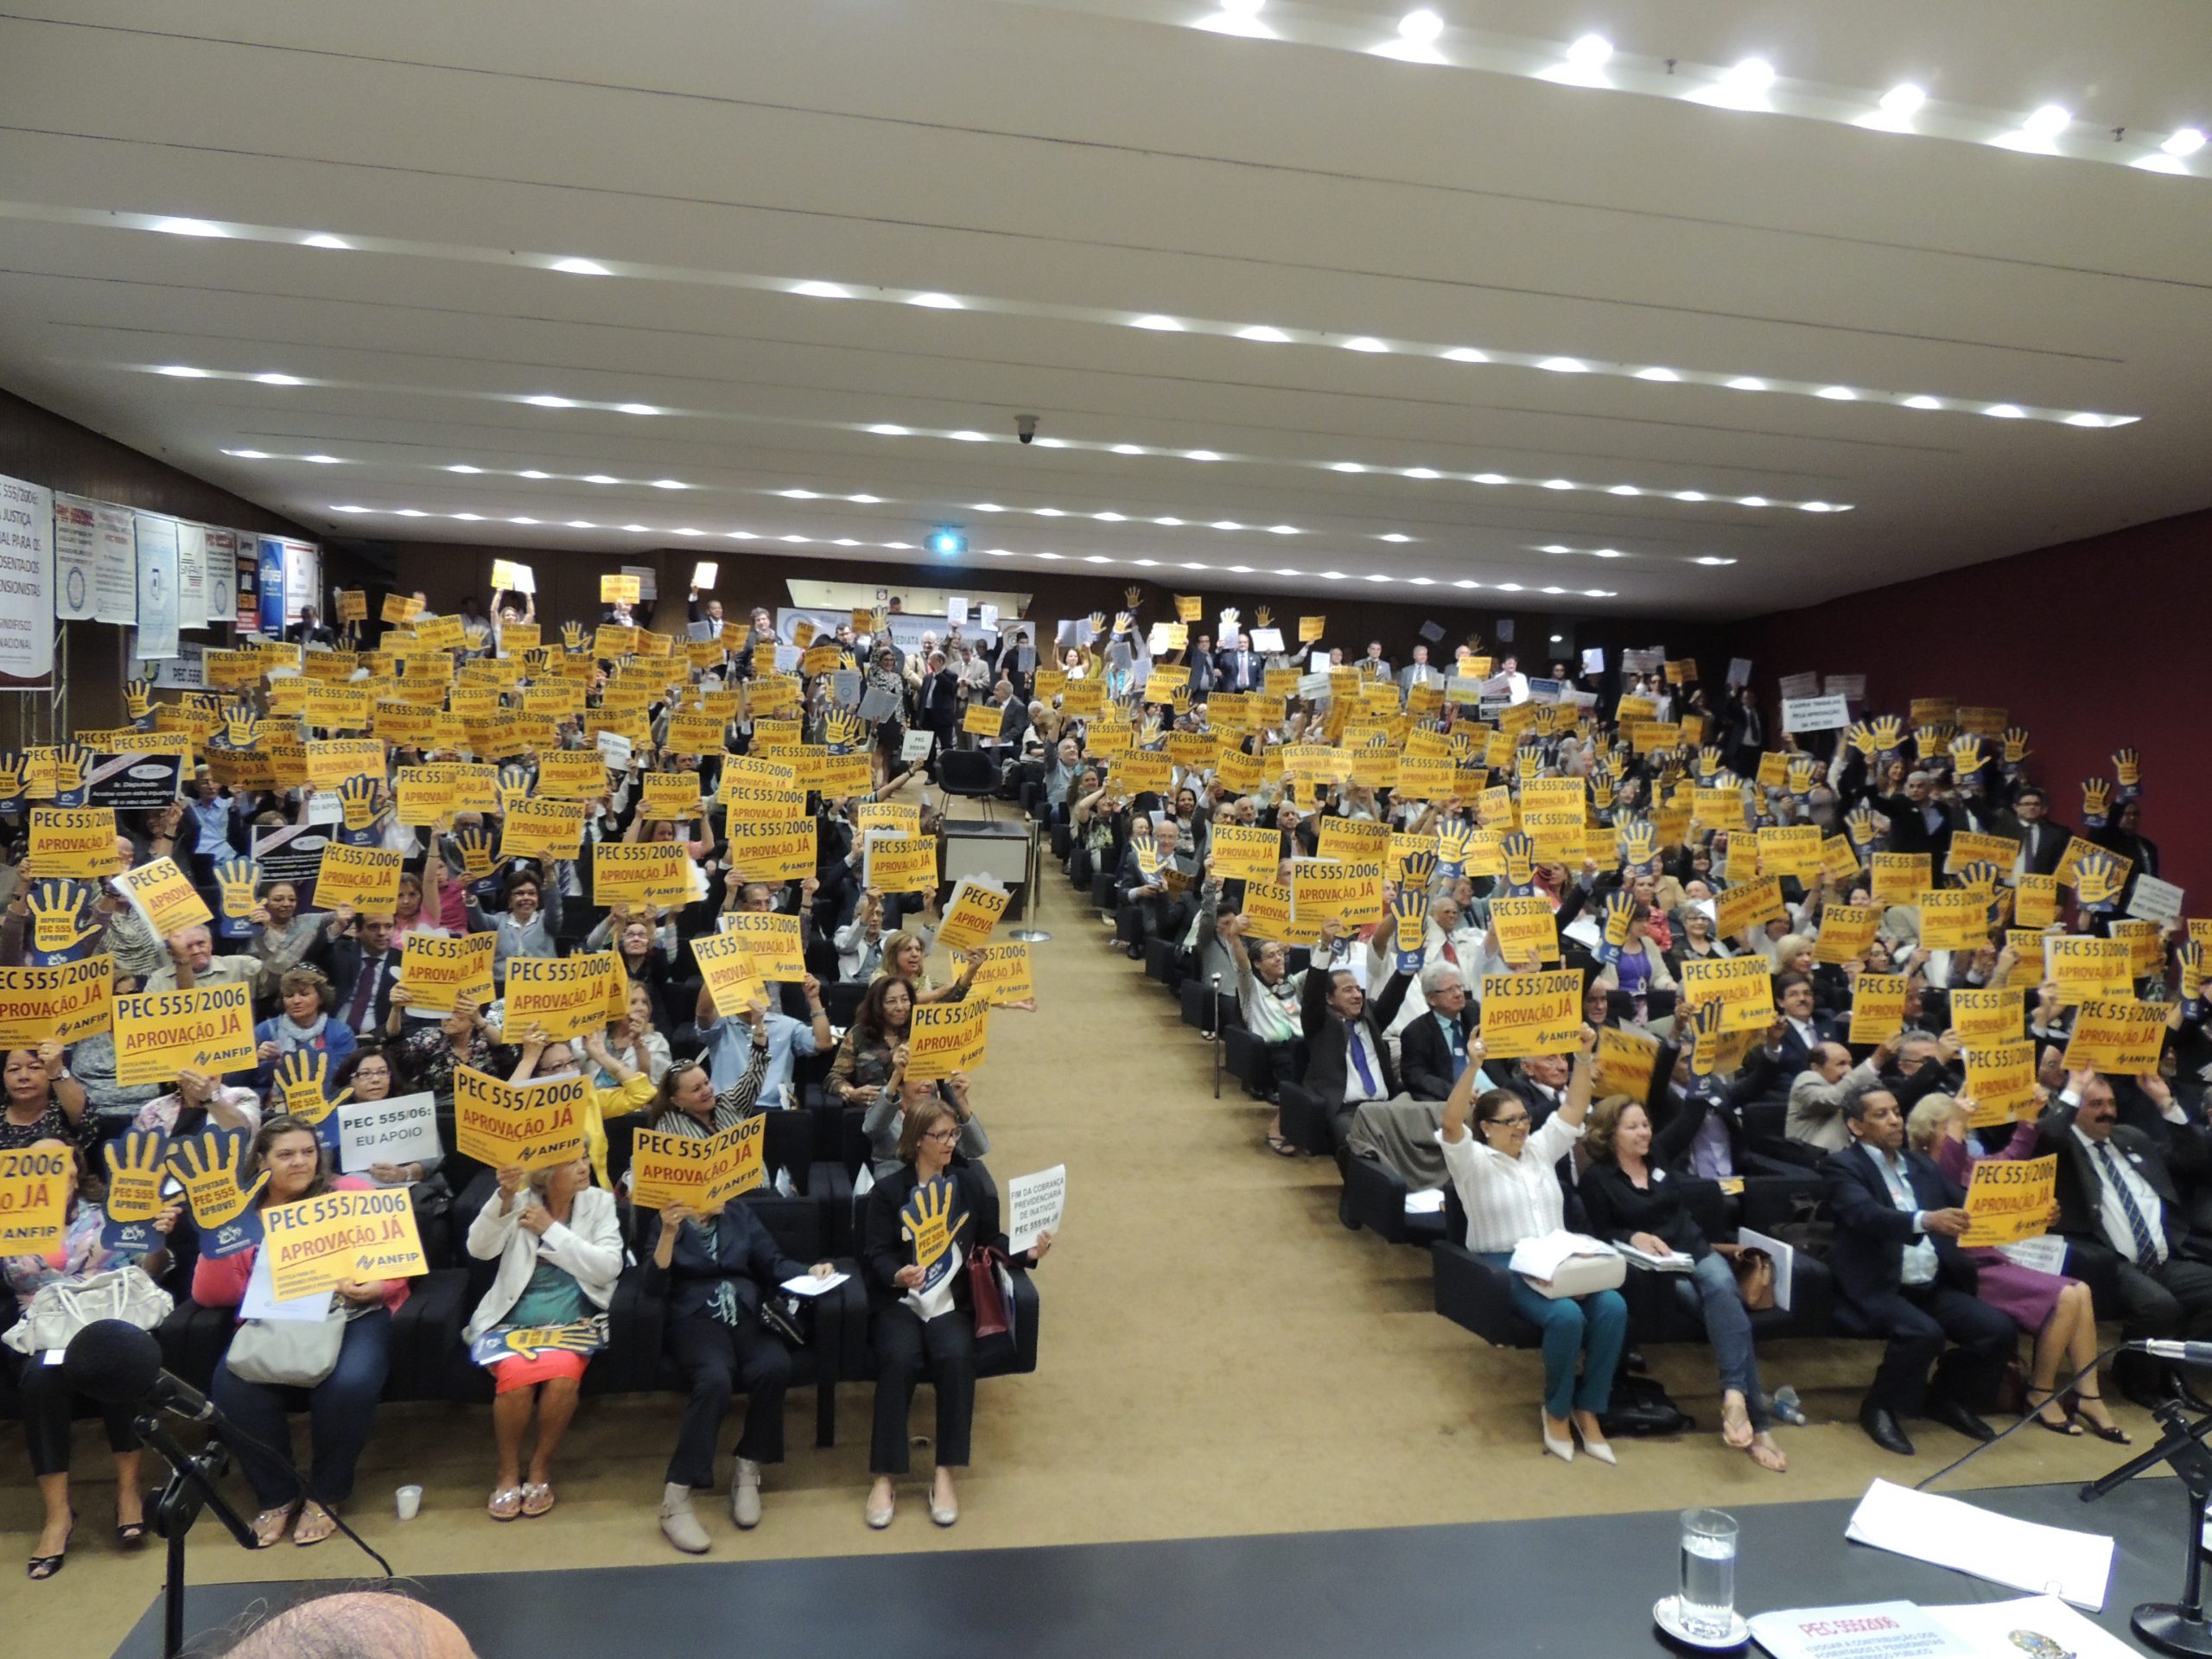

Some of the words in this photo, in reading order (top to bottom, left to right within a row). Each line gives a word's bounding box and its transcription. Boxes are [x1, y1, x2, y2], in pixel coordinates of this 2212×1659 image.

[3, 509, 32, 529] JUSTIÇA
[12, 534, 31, 550] PARA
[309, 743, 332, 755] PEC
[543, 752, 560, 762] PEC
[771, 747, 786, 756] PEC
[726, 757, 743, 770] PEC
[746, 760, 793, 778] 555/2006
[1400, 757, 1415, 766] PEC
[401, 769, 425, 783] PEC
[1522, 780, 1540, 791] PEC
[731, 786, 753, 799] PEC
[755, 788, 804, 804] 555/2006
[510, 799, 534, 814] PEC
[536, 802, 583, 818] 555/2006
[786, 804, 798, 817] JÁ
[35, 812, 59, 828] PEC
[1324, 819, 1343, 831] PEC
[1524, 814, 1541, 824] PEC
[734, 823, 757, 836] PEC
[760, 821, 814, 836] 555/2006
[1215, 828, 1232, 840] PEC
[1236, 830, 1279, 843] 555/2006
[795, 836, 810, 853] JÁ
[873, 842, 892, 854] PEC
[1263, 845, 1274, 859] JÁ
[325, 844, 342, 859] PEC
[342, 849, 399, 868] 555/2006
[596, 847, 620, 860] PEC
[624, 846, 683, 861] 555/2006
[920, 854, 930, 866] JÁ
[664, 861, 677, 877] JÁ
[791, 861, 814, 870] ANFIP
[1296, 864, 1317, 879] PEC
[1320, 863, 1379, 880] 555/2006
[129, 869, 157, 890] PEC
[376, 869, 391, 887] JÁ
[656, 887, 684, 895] ANFIP
[962, 887, 988, 910] PEC
[1248, 883, 1268, 897] PEC
[1300, 885, 1356, 900] APROVAÇÃO
[1360, 881, 1374, 897] JÁ
[1353, 906, 1379, 916] ANFIP
[1492, 900, 1510, 916] PEC
[55, 925, 71, 933] 555
[728, 914, 752, 931] PEC
[754, 916, 798, 933] 555/2006
[407, 937, 435, 957] PEC
[696, 940, 721, 962] PEC
[2054, 940, 2081, 956] PEC
[471, 953, 485, 974] JÁ
[511, 962, 543, 981] PEC
[547, 959, 612, 982] 555/2006
[1687, 963, 1711, 980] PEC
[1716, 959, 1768, 977] 555/2006
[0, 971, 17, 990] EC
[23, 959, 109, 990] 555/2006
[83, 980, 102, 1006] JÁ
[463, 982, 492, 996] ANFIP
[589, 977, 604, 999] JÁ
[1484, 977, 1512, 996] PEC
[1516, 974, 1580, 996] 555/2006
[1859, 978, 1885, 994] PEC
[118, 997, 156, 1020] PEC
[161, 987, 245, 1015] 555/2006
[1488, 1005, 1554, 1025] APROVAÇÃO
[1557, 997, 1573, 1017] JÁ
[2080, 1000, 2104, 1019] PEC
[73, 1013, 108, 1031] ANFIP
[581, 1010, 606, 1025] ANFIP
[916, 1007, 942, 1027] PEC
[126, 1020, 214, 1049] APROVAÇÃO
[221, 1008, 242, 1035] JÁ
[971, 1019, 983, 1039] JÁ
[1549, 1030, 1580, 1040] ANFIP
[213, 1046, 252, 1061] ANFIP
[1969, 1050, 1993, 1068] PEC
[459, 1076, 487, 1101] PEC
[492, 1081, 584, 1112] 555/2006
[343, 1117, 375, 1130] PEC
[379, 1107, 432, 1124] 555/06:
[463, 1108, 544, 1141] APROVAÇÃO
[550, 1107, 574, 1131] JÁ
[356, 1135, 375, 1147] EU
[379, 1126, 423, 1144] APOIO
[638, 1133, 673, 1156] PEC
[678, 1119, 760, 1160] 555/2006
[537, 1137, 581, 1154] ANFIP
[3, 1153, 64, 1178] 2006
[643, 1159, 728, 1185] APROVAÇÃO
[733, 1140, 752, 1167] JÁ
[723, 1167, 760, 1192] ANFIP
[1974, 1166, 2003, 1185] PEC
[21, 1179, 50, 1208] JÁ
[113, 1187, 132, 1199] PEC
[135, 1187, 155, 1199] 555
[192, 1177, 230, 1193] DEPUTADO
[1011, 1190, 1021, 1199] FIM
[1023, 1188, 1032, 1197] DA
[193, 1192, 215, 1207] PEC
[215, 1185, 236, 1202] 555
[114, 1199, 150, 1211] APROVE!
[200, 1199, 237, 1217] APROVE!
[269, 1205, 308, 1233] PEC
[315, 1193, 407, 1224] 555/2006
[1020, 1211, 1027, 1220] DE
[3, 1226, 57, 1237] ANFIP
[280, 1224, 376, 1262] APROVAÇÃO
[381, 1214, 405, 1241] JÁ
[1015, 1224, 1028, 1235] PEC
[377, 1251, 420, 1267] ANFIP
